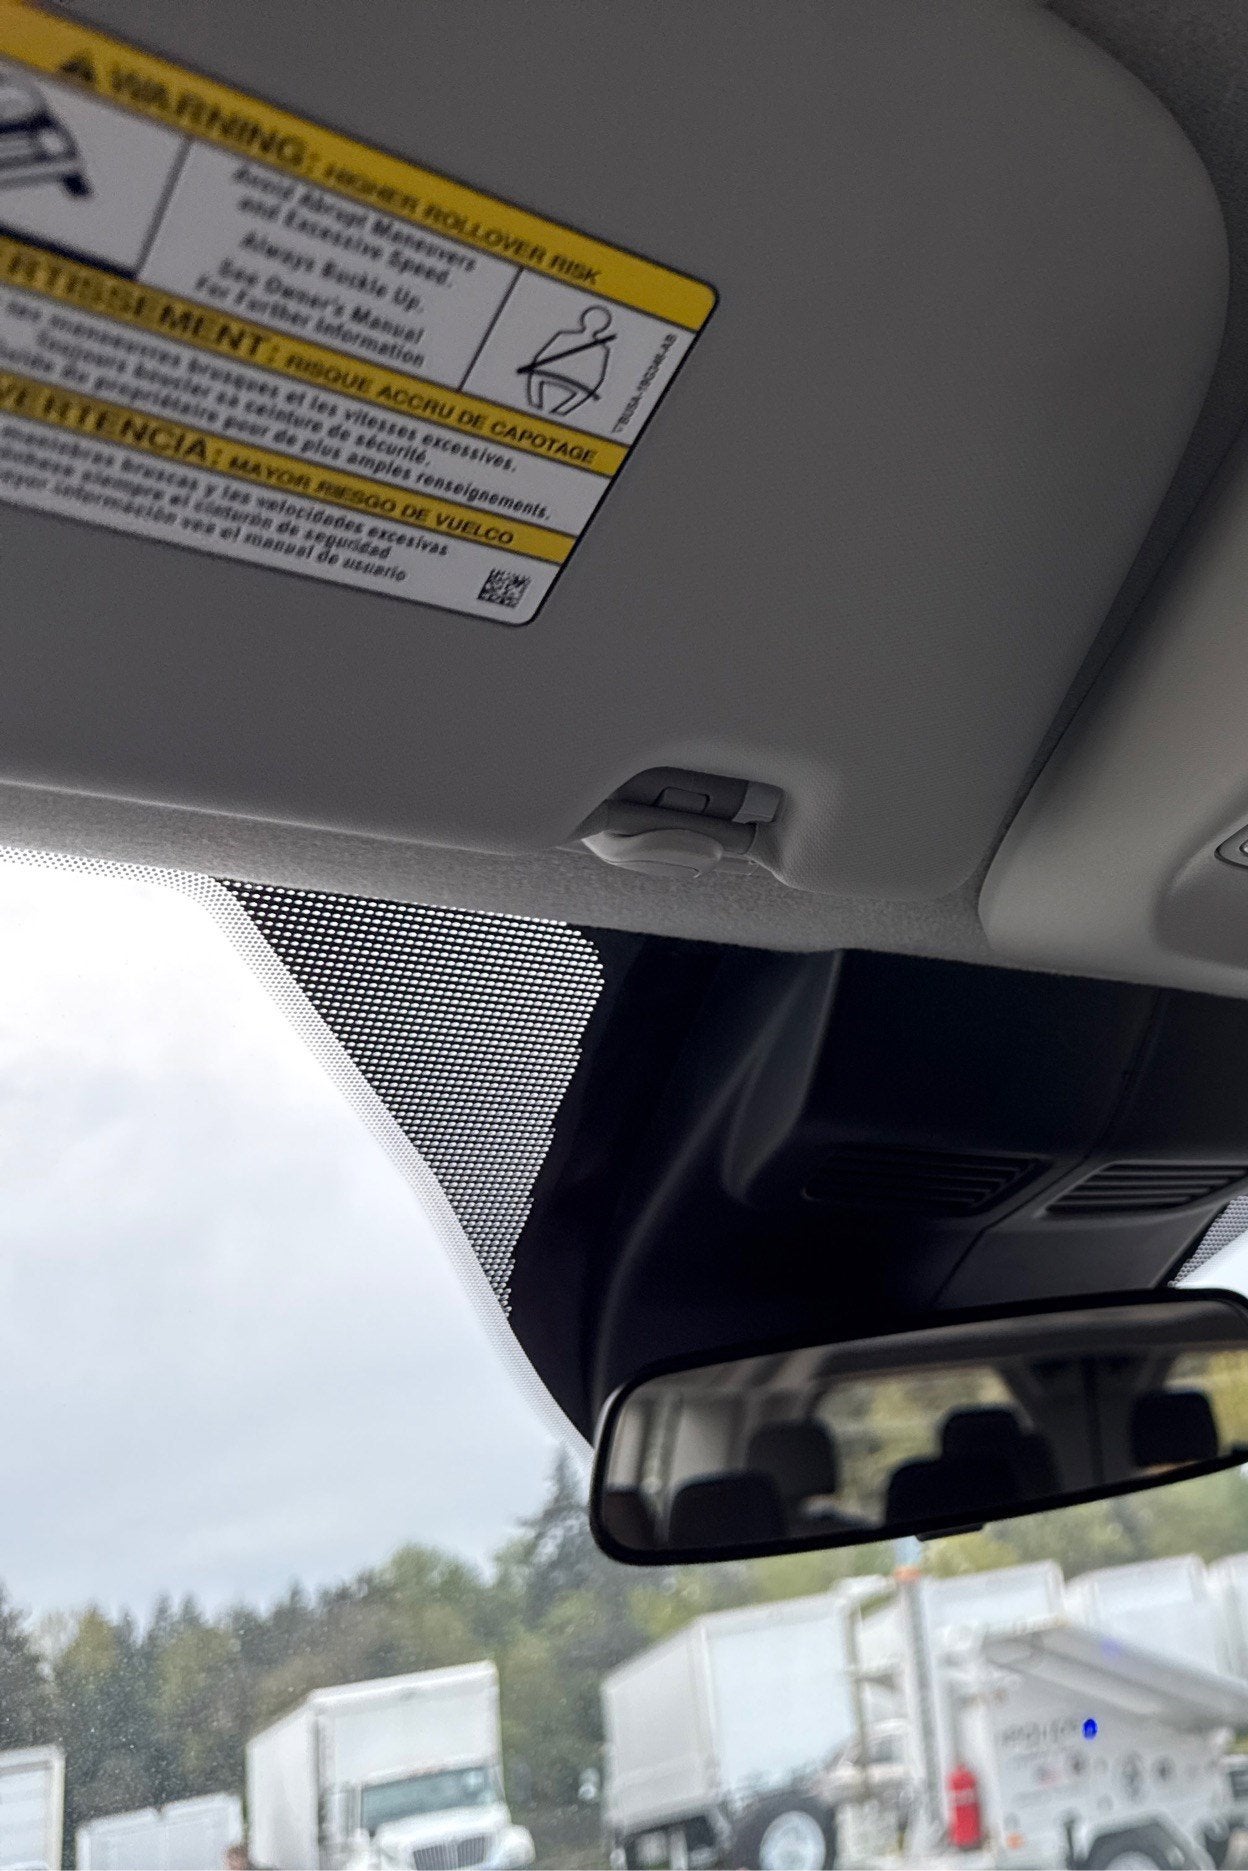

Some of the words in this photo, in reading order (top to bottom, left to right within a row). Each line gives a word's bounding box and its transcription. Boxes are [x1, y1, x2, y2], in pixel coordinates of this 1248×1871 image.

[105, 60, 320, 171] WARNING:
[419, 200, 550, 266] ROLLOVER
[547, 252, 603, 287] RISK
[230, 160, 296, 203] Avoid
[296, 186, 370, 233] Abrupt
[367, 215, 480, 274] Maneuvers
[235, 191, 282, 224] and
[280, 209, 386, 262] Excessive
[384, 250, 456, 292] Speed.
[238, 228, 318, 274] Always
[320, 259, 388, 298] Buckle
[389, 285, 428, 315] Up.
[194, 273, 232, 300] For
[233, 287, 312, 328] Further
[312, 314, 428, 368] Information
[218, 257, 262, 288] See
[262, 273, 346, 317] Owner's
[349, 305, 425, 345] Manual
[131, 362, 212, 400] boucler
[214, 389, 241, 409] sa
[242, 396, 325, 434] ceinture
[326, 422, 353, 442] de
[352, 428, 436, 467] sécurité.
[185, 356, 283, 402] brusques
[284, 387, 307, 407] et
[306, 394, 340, 418] les
[341, 405, 421, 442] vitesses
[419, 429, 522, 473] excessives.
[283, 352, 375, 394] RISQUE
[374, 381, 456, 419] ACCRU
[455, 407, 489, 430] DE
[487, 418, 599, 465] CAPOTAGE
[219, 413, 271, 441] pour
[271, 427, 300, 448] de
[298, 435, 344, 463] plus
[344, 449, 415, 483] amples
[412, 467, 556, 523] renseignements.
[226, 454, 313, 490] MAYOR
[313, 478, 400, 514] RIESGO
[399, 502, 431, 522] DE
[431, 511, 518, 546] VUELCO
[166, 490, 192, 509] el
[274, 518, 302, 538] de
[301, 525, 393, 563] seguridad
[201, 482, 217, 498] y
[219, 484, 253, 506] las
[253, 493, 367, 535] velocidades
[365, 523, 453, 558] excesivas
[218, 524, 242, 542] el
[241, 529, 315, 560] manual
[313, 547, 341, 566] de
[340, 555, 410, 584] usuario
